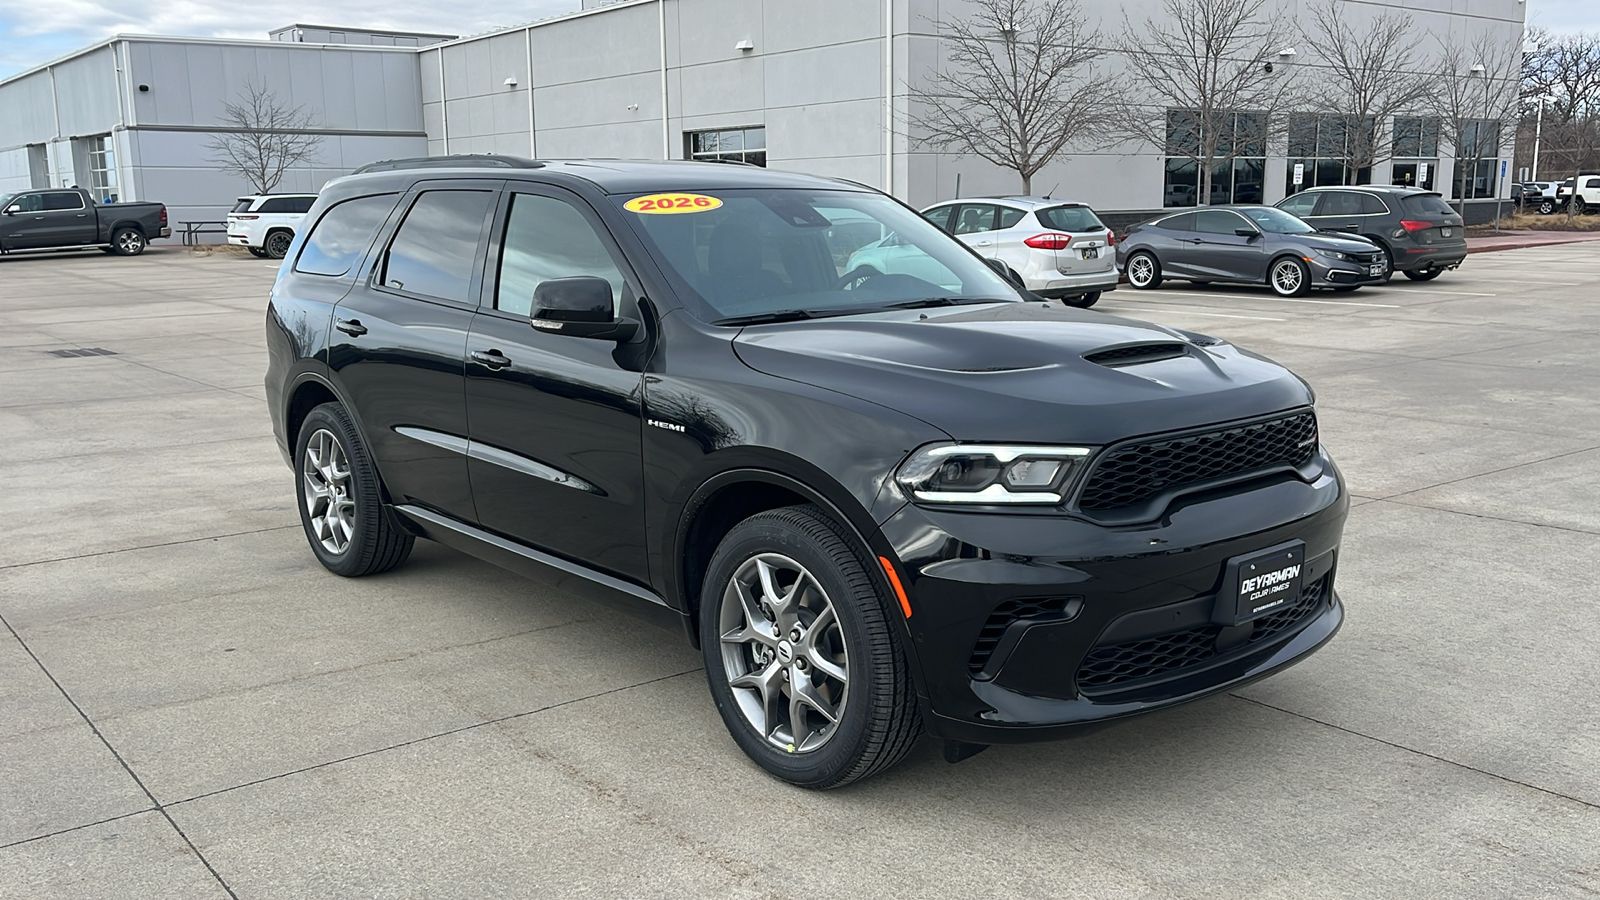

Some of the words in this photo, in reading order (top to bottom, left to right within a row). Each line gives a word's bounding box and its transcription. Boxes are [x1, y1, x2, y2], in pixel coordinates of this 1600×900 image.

[638, 198, 710, 210] 2026
[647, 419, 685, 432] HEMI
[1241, 564, 1300, 594] DEYARMAN
[1270, 582, 1290, 593] AMES
